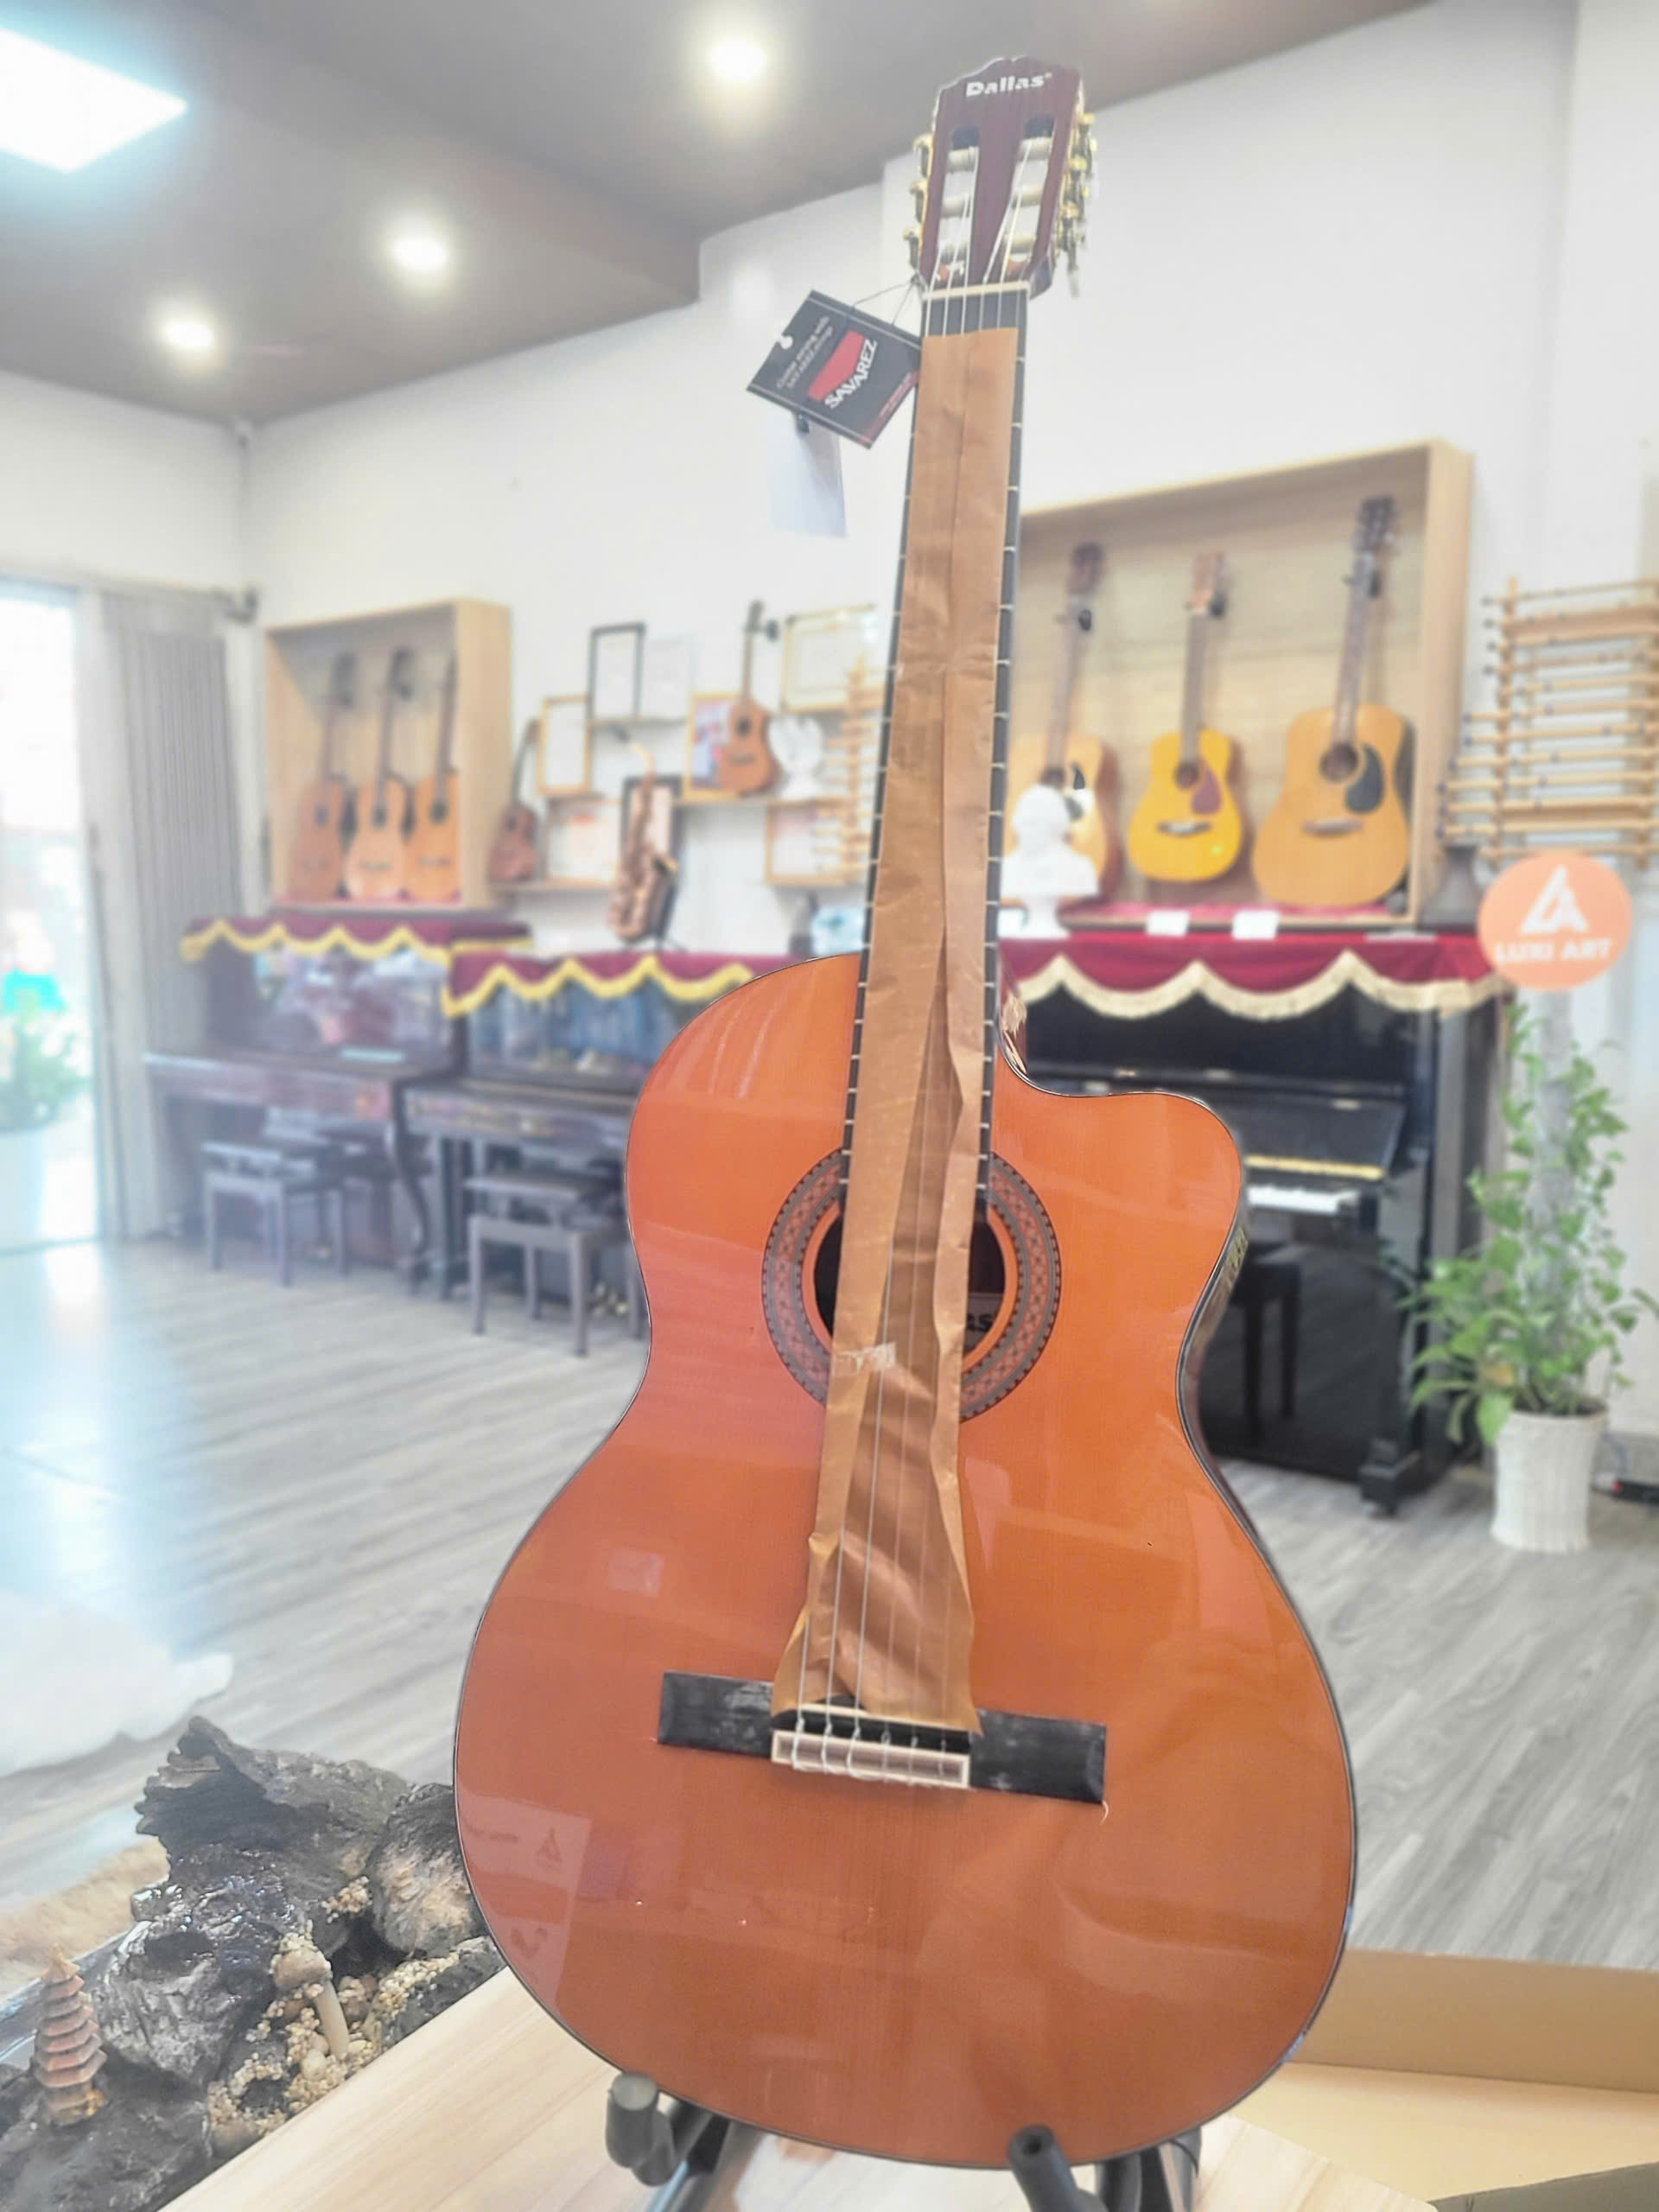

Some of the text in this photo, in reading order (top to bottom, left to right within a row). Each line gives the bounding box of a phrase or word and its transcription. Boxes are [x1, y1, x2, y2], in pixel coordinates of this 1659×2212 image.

[966, 75, 1045, 97] Dallas
[823, 338, 878, 409] SAVAREZ
[1560, 938, 1612, 959] ART
